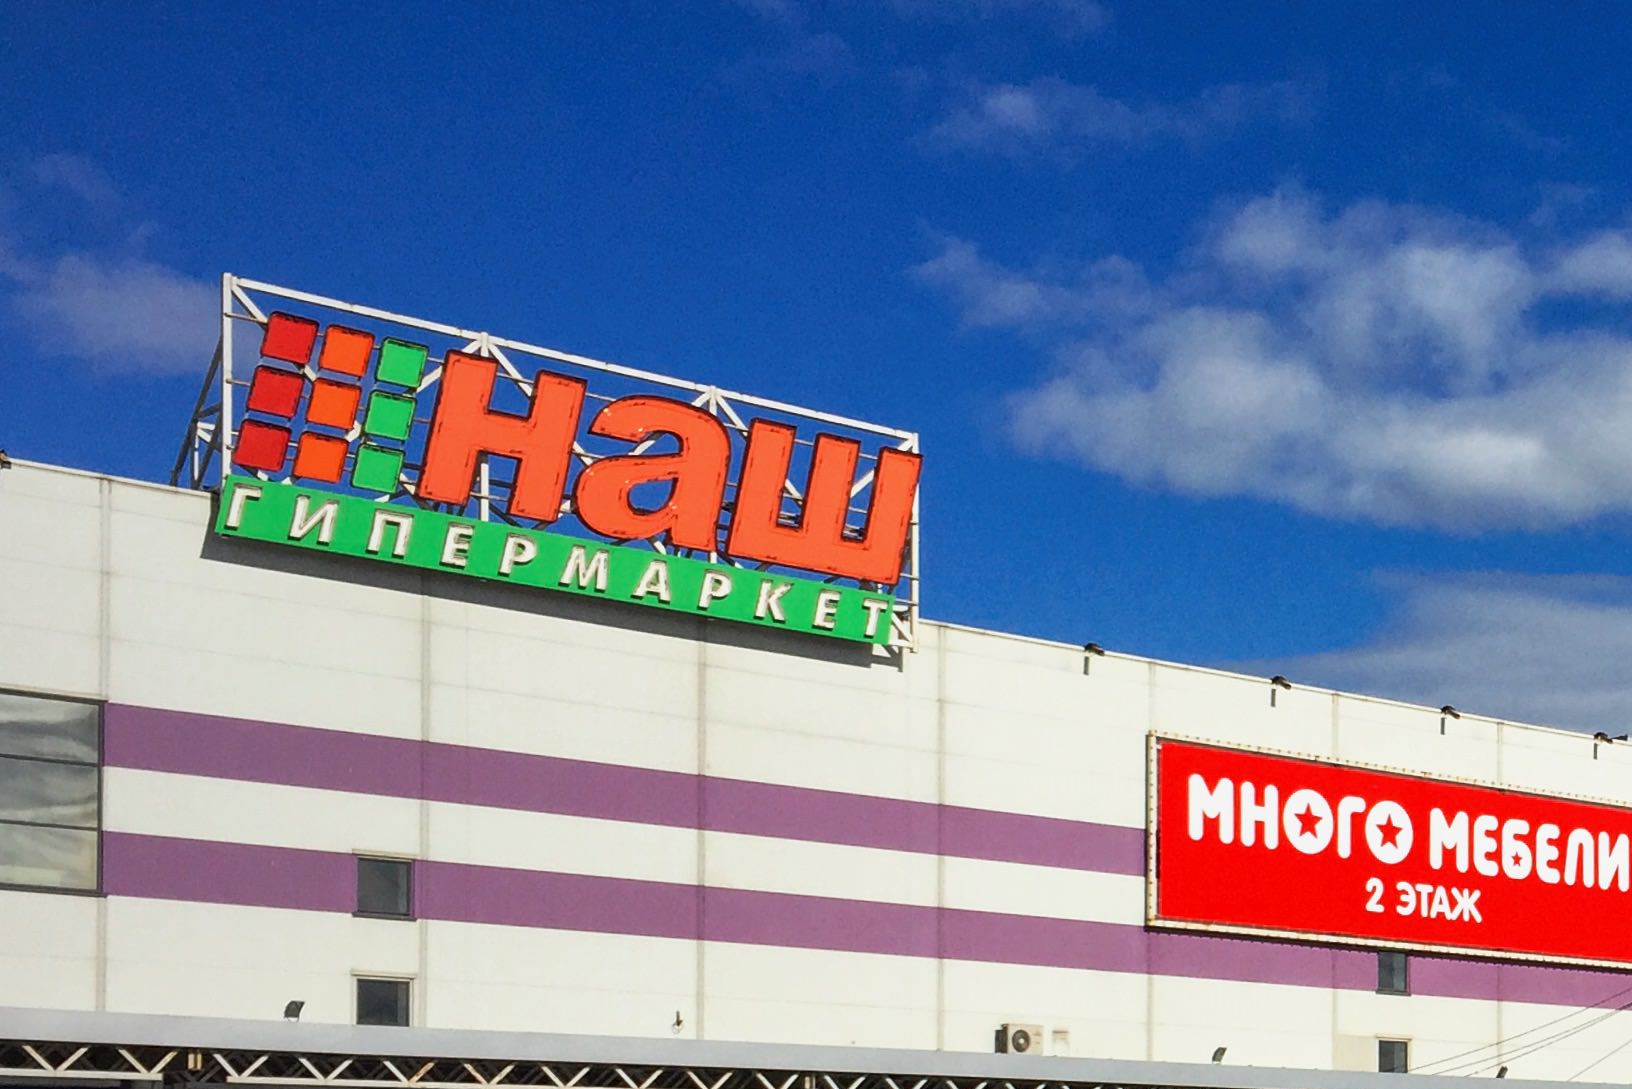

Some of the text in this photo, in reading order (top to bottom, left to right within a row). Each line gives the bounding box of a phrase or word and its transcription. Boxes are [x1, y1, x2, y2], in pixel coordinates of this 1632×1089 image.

[226, 483, 889, 638] ГИПЕРМАРКЕТ
[1187, 773, 1631, 893] МНОГО МЕБЕЛИ
[1365, 877, 1482, 924] 2 ЭТАЖ
